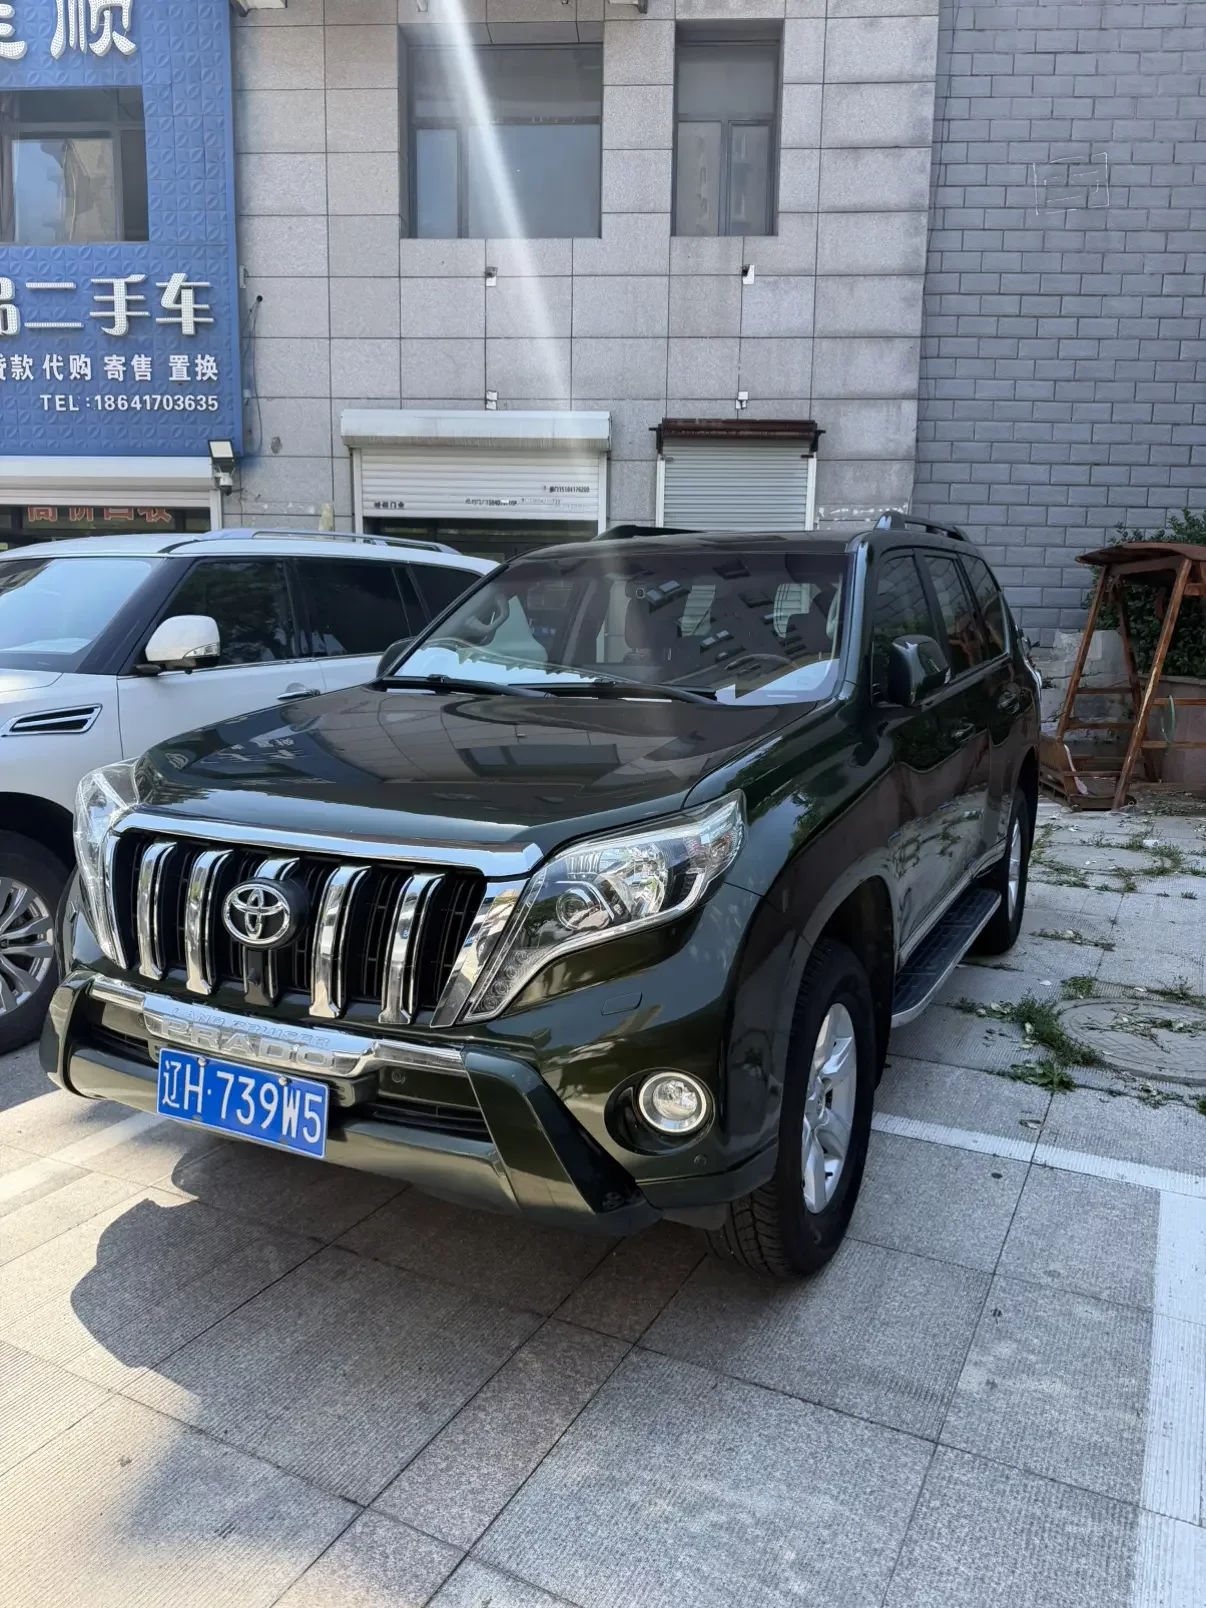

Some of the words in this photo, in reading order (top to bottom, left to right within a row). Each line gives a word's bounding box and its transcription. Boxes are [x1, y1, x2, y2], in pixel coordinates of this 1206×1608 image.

[0, 0, 137, 59] 顺
[0, 353, 34, 380] 款
[42, 353, 92, 381] 代购
[103, 354, 152, 382] 寄售
[168, 354, 219, 381] 置换
[172, 1007, 226, 1027] LAND
[161, 1015, 335, 1069] PRADO
